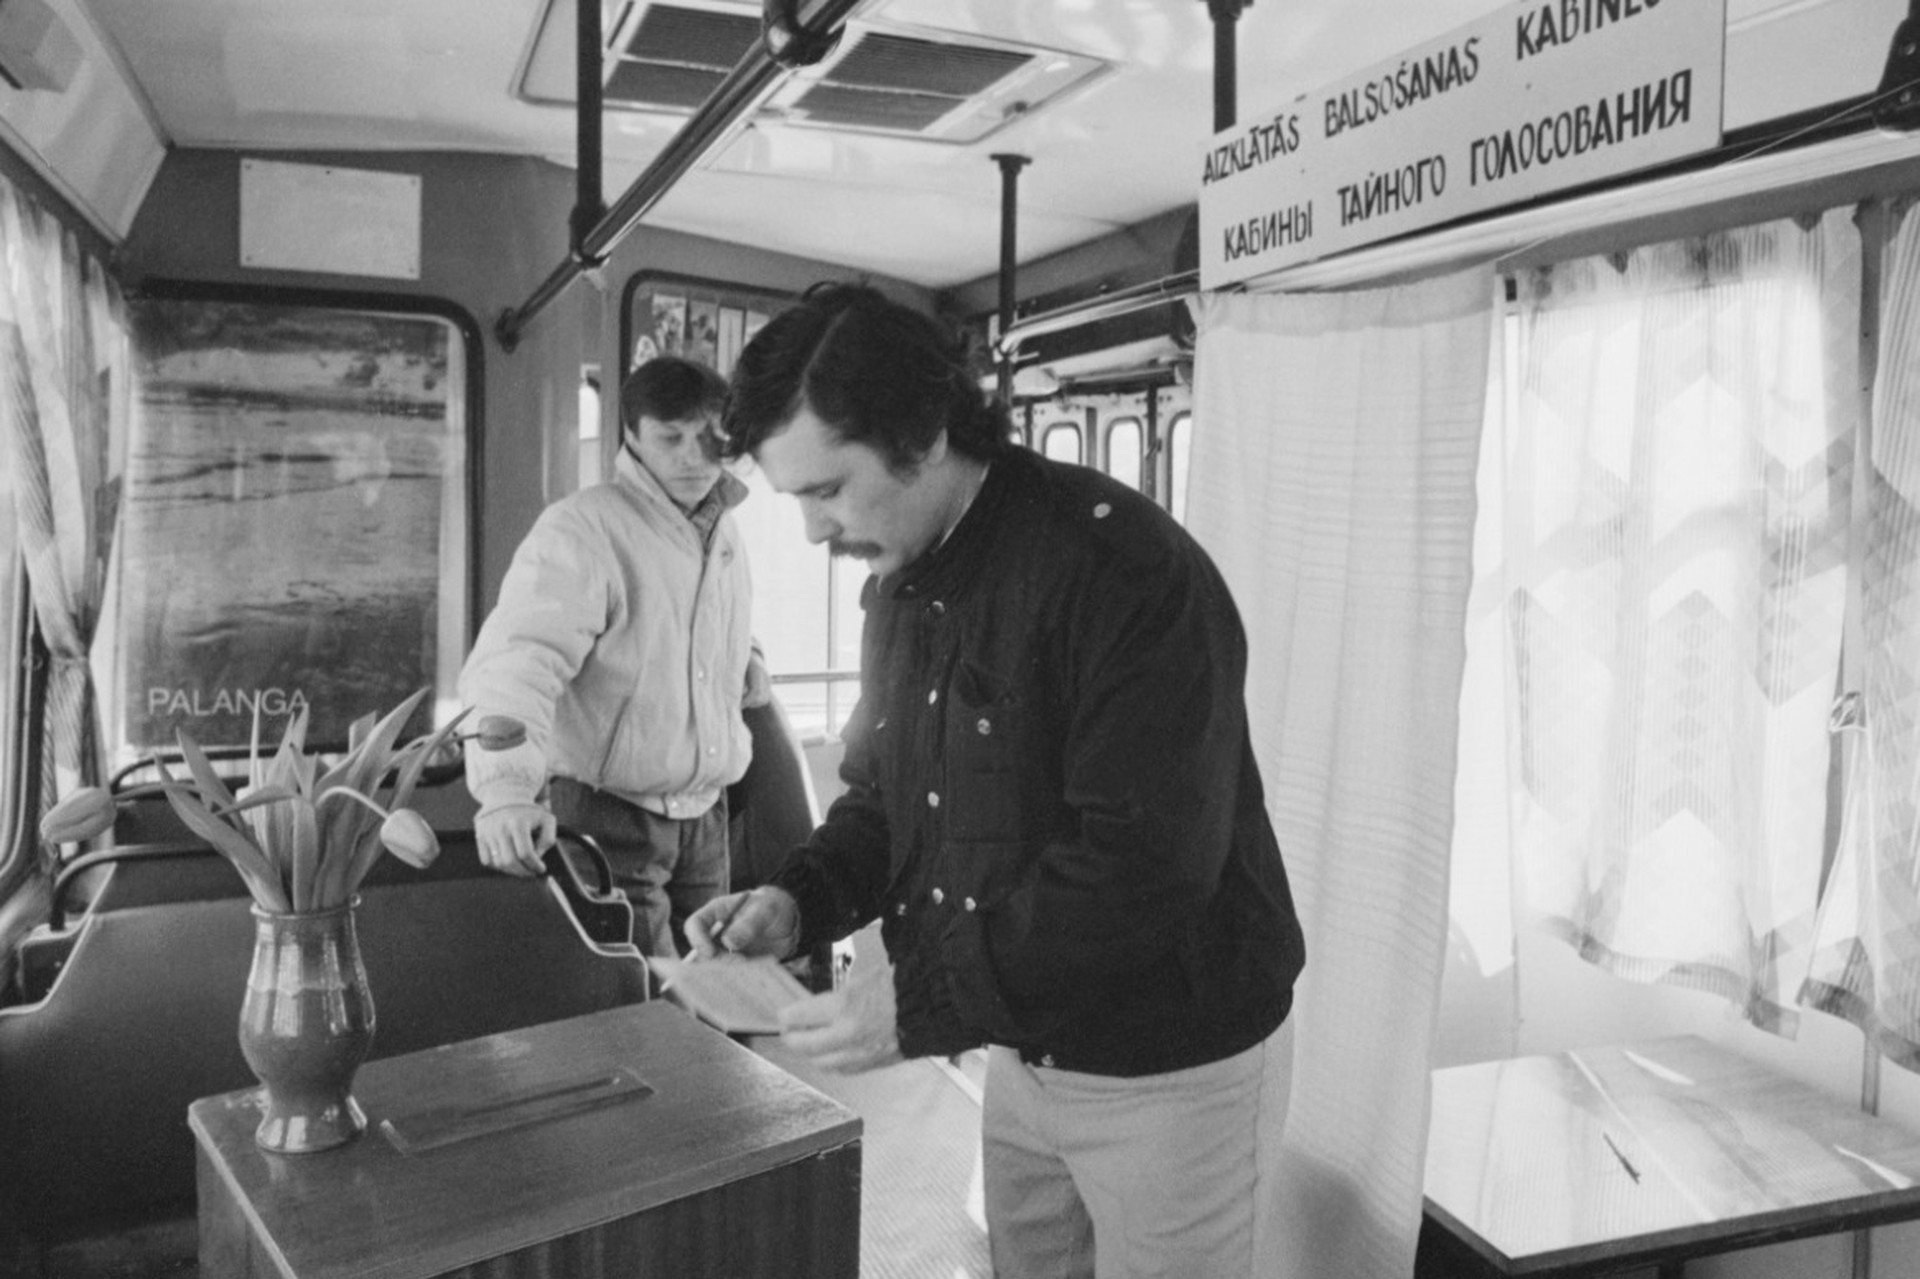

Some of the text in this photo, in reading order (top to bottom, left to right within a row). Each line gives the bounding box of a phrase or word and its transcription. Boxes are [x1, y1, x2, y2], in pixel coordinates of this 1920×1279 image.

[1202, 114, 1300, 187] AIZKLĀTĀS
[1516, 0, 1661, 61] KABIN
[1224, 68, 1692, 262] КАБИНЫ ТАЙНОГО ГОЛОСОВАНИЯ
[147, 686, 306, 717] PALANGA
